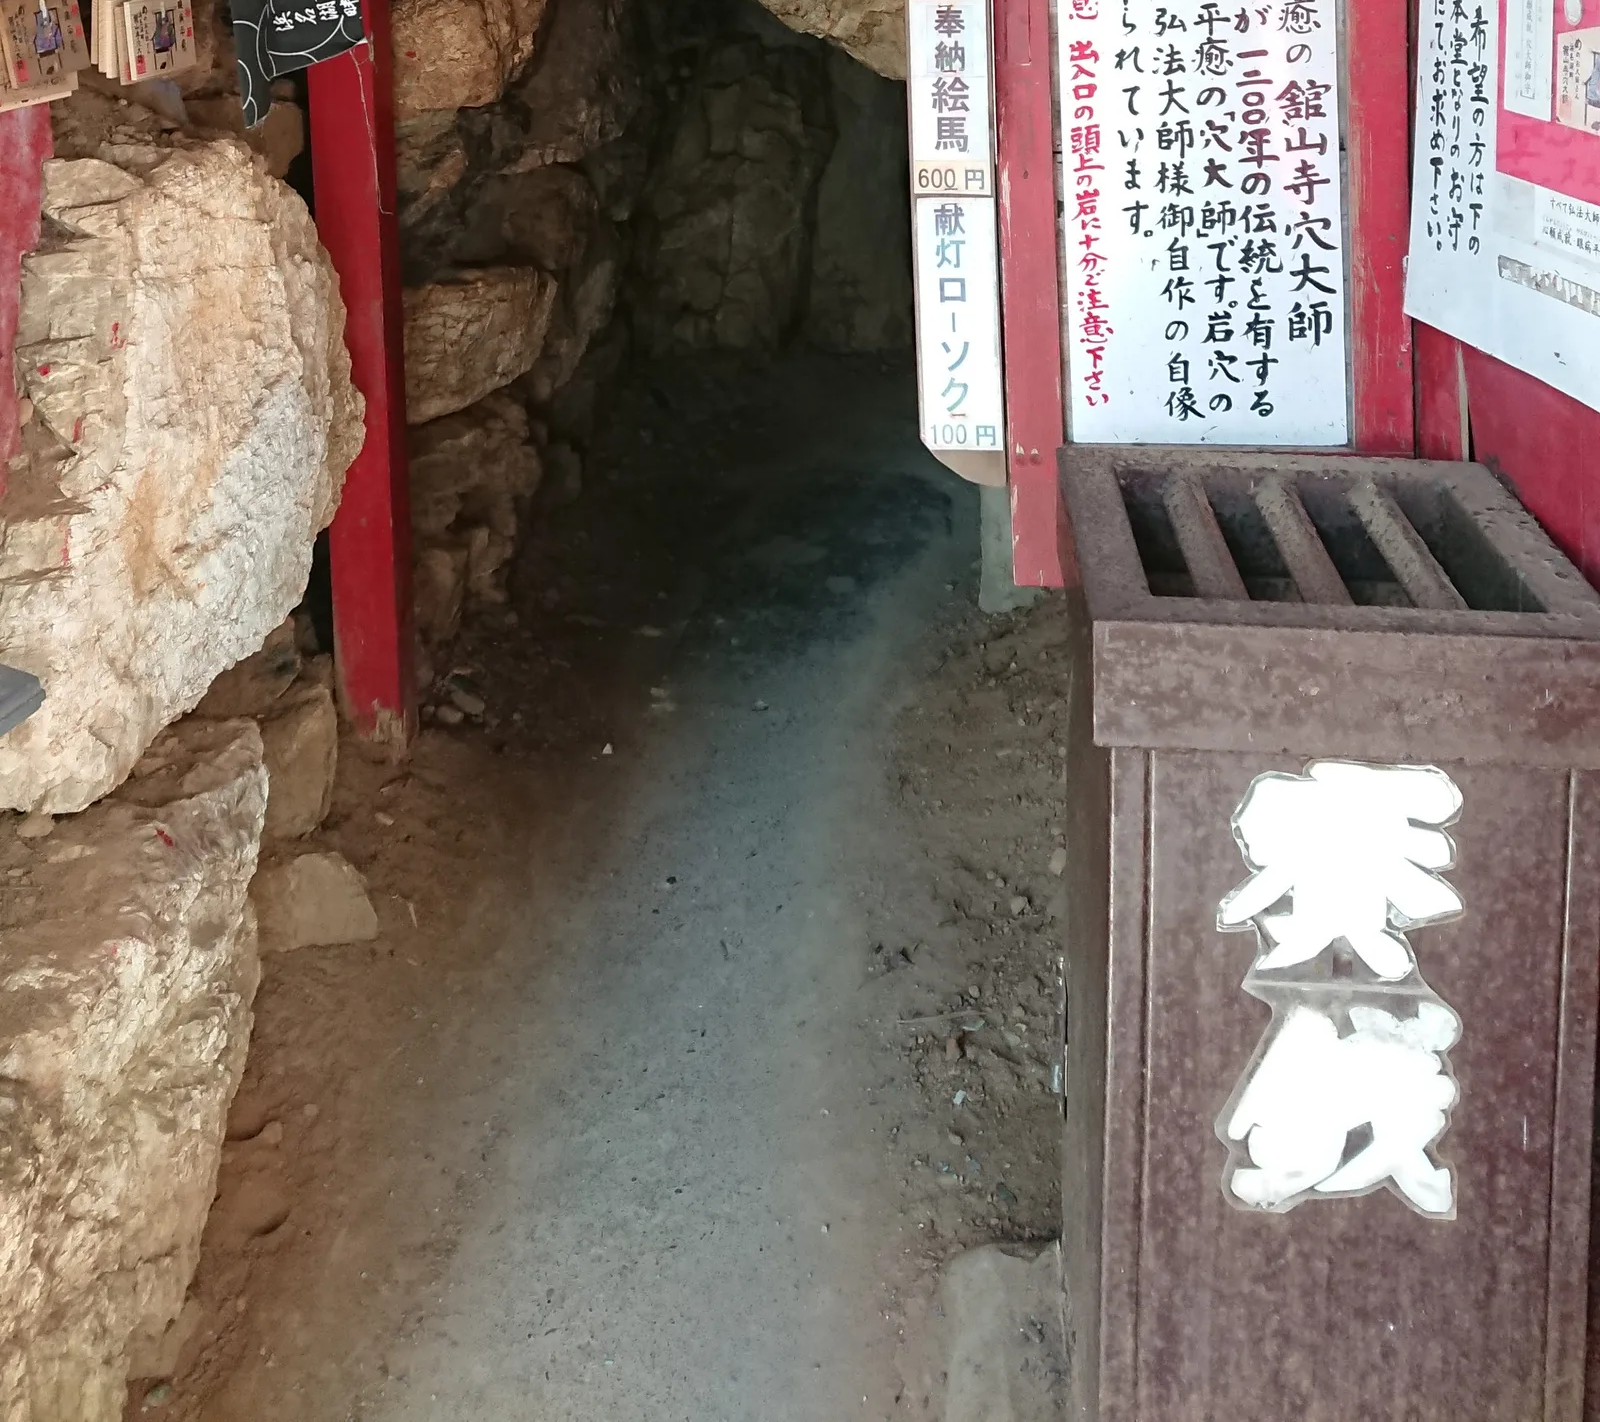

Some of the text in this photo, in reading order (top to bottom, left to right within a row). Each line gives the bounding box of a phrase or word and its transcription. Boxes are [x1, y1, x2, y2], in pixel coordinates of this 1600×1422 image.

[930, 4, 971, 153] 奉納絵馬
[933, 203, 970, 417] 献灯ローソク
